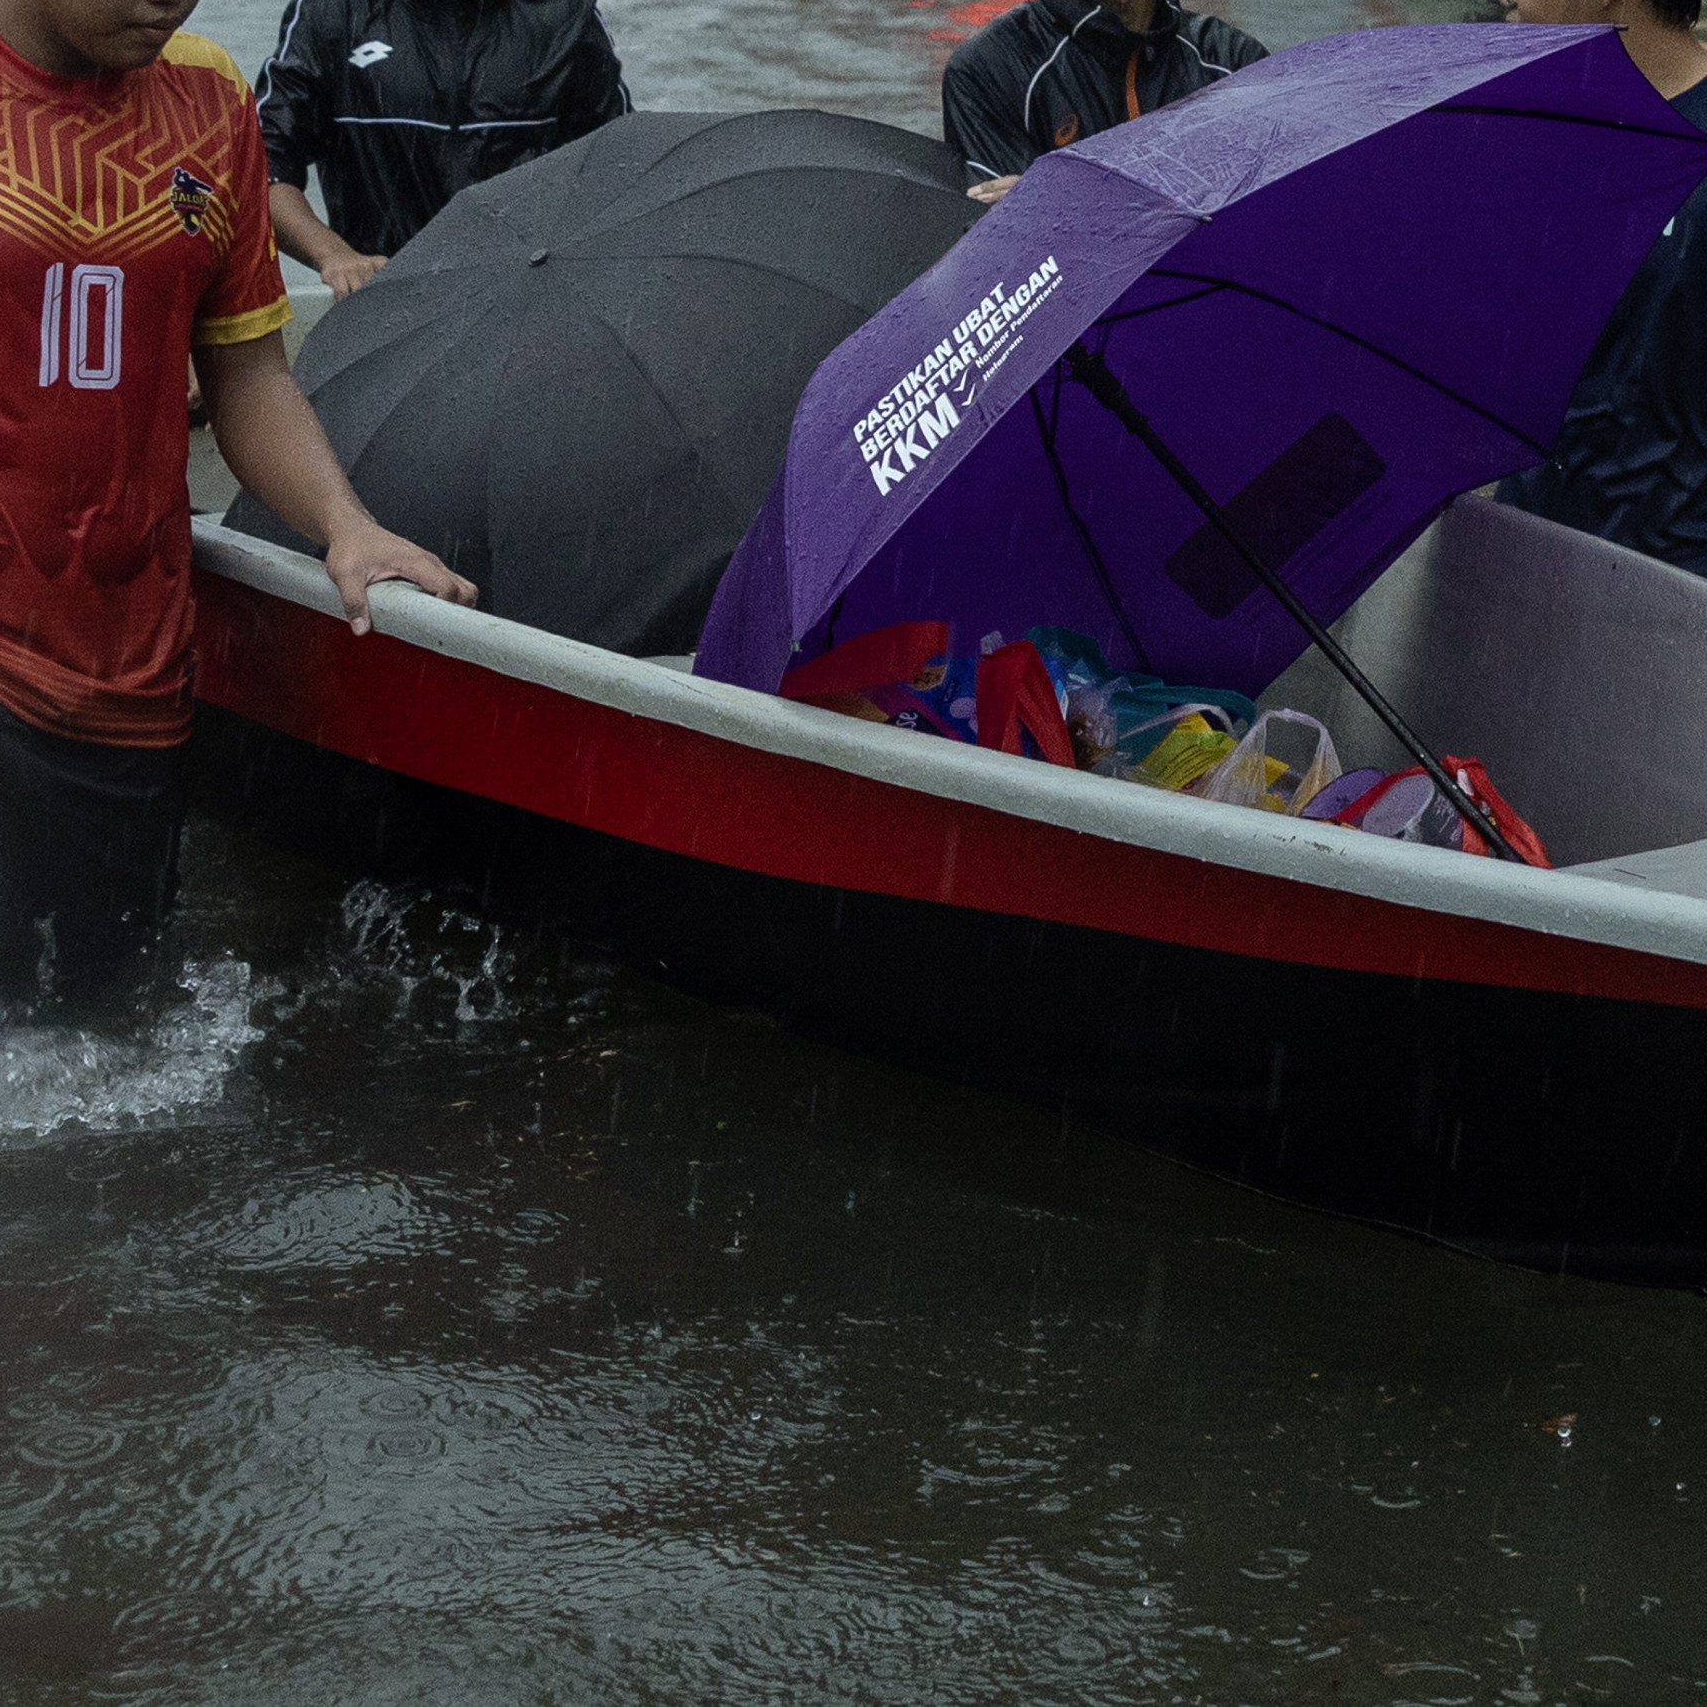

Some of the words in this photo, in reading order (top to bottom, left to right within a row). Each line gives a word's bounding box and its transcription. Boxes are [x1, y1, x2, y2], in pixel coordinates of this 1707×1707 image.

[39, 262, 125, 390] 10
[853, 338, 954, 443] PASTIKAN
[952, 281, 1005, 344] UBAT
[860, 340, 978, 462] BERDAFTAR
[976, 255, 1059, 346] DENGAN
[975, 331, 1010, 369] Nombor
[1010, 275, 1064, 332] Pendaftaran
[869, 392, 960, 497] KKM
